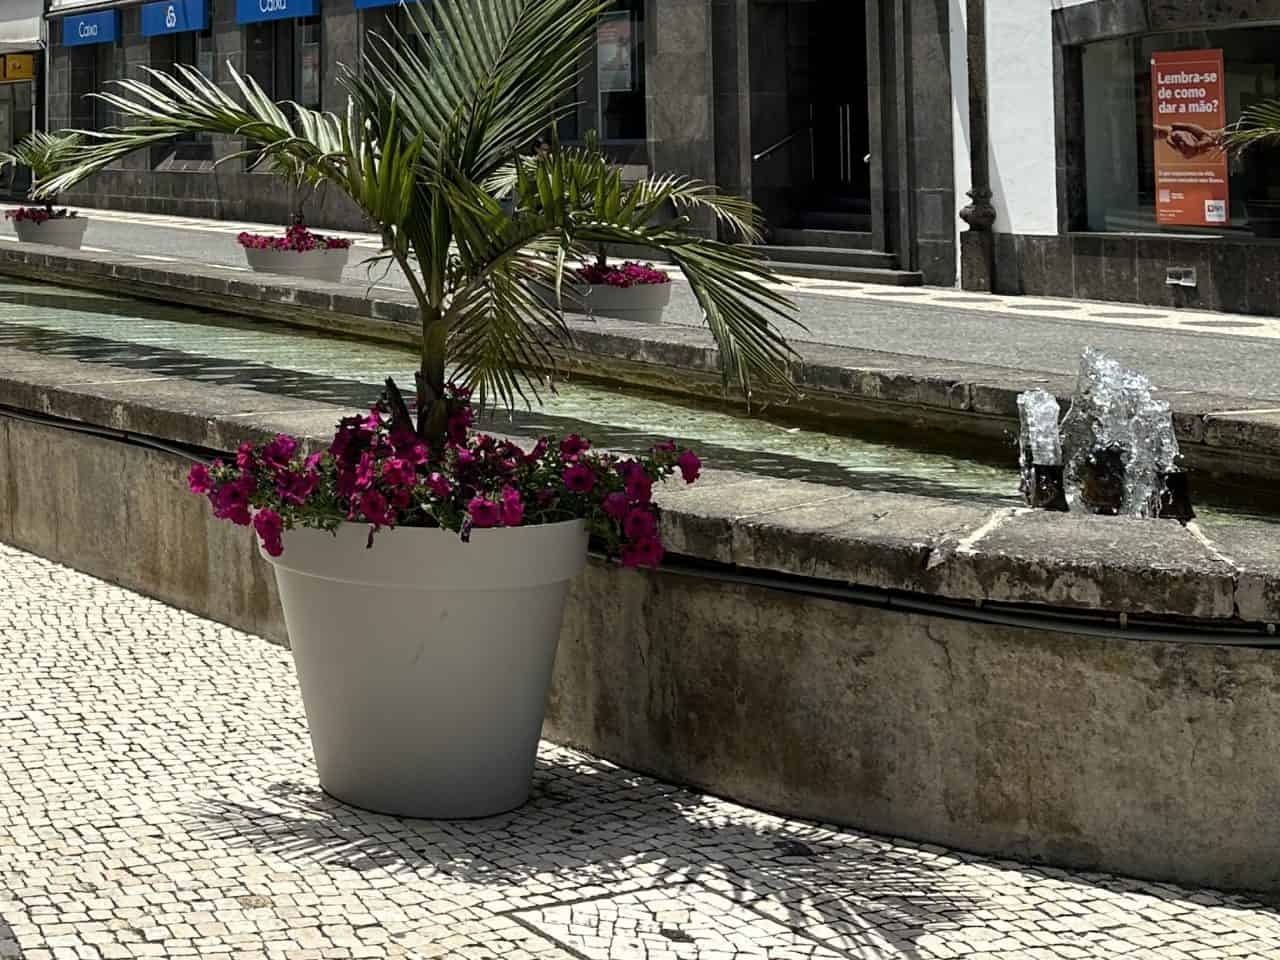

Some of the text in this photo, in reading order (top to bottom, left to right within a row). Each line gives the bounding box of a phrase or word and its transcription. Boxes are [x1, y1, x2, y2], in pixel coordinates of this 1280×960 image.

[79, 21, 98, 38] Caixa
[1157, 71, 1217, 85] Lembra-se
[1158, 87, 1206, 99] de como
[1159, 100, 1219, 114] dar a mão?
